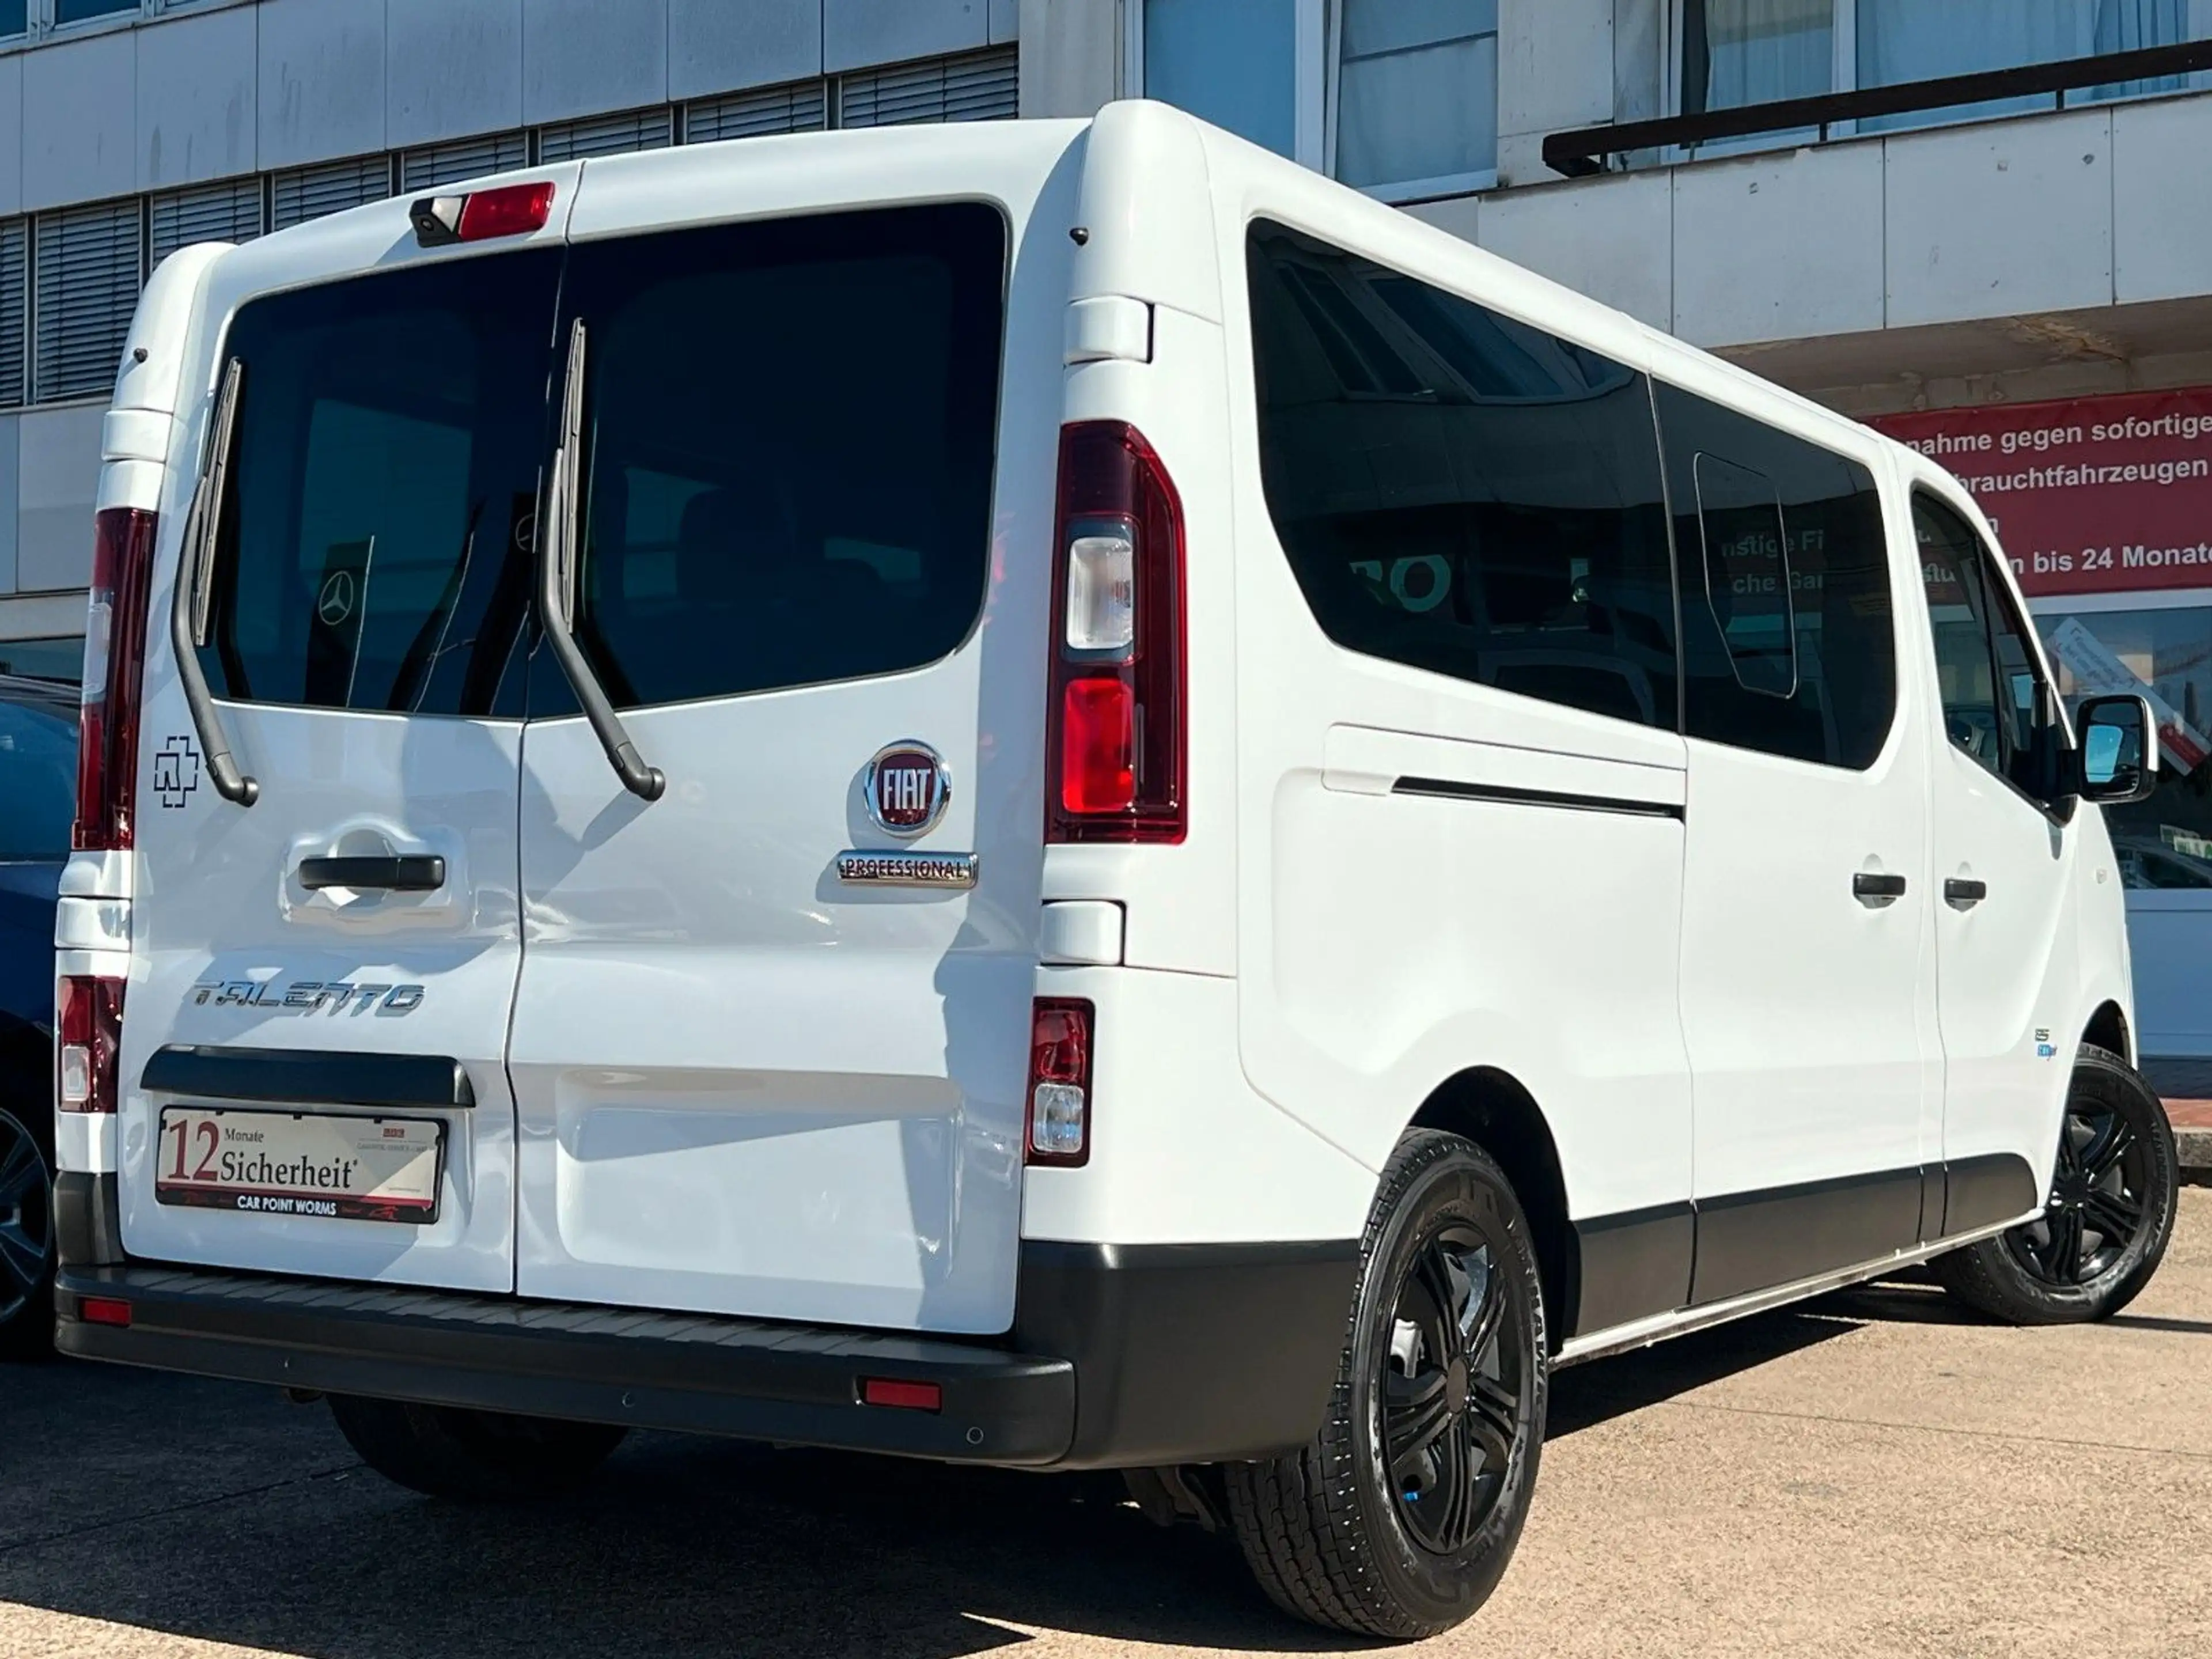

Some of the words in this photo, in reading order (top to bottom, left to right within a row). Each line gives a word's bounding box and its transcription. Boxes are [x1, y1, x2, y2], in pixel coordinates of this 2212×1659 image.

[2001, 423, 2082, 453] gegen
[2033, 551, 2073, 573] bis
[2082, 548, 2113, 571] 24
[2122, 543, 2212, 568] Monat
[882, 768, 931, 810] FIAT
[846, 859, 963, 879] PROFESSIONAL
[193, 981, 426, 1009] TALENTO
[168, 1119, 219, 1182] 12
[225, 1128, 264, 1143] Monate
[237, 1195, 260, 1209] CAR
[263, 1197, 294, 1211] POINT
[295, 1200, 337, 1215] WORMS
